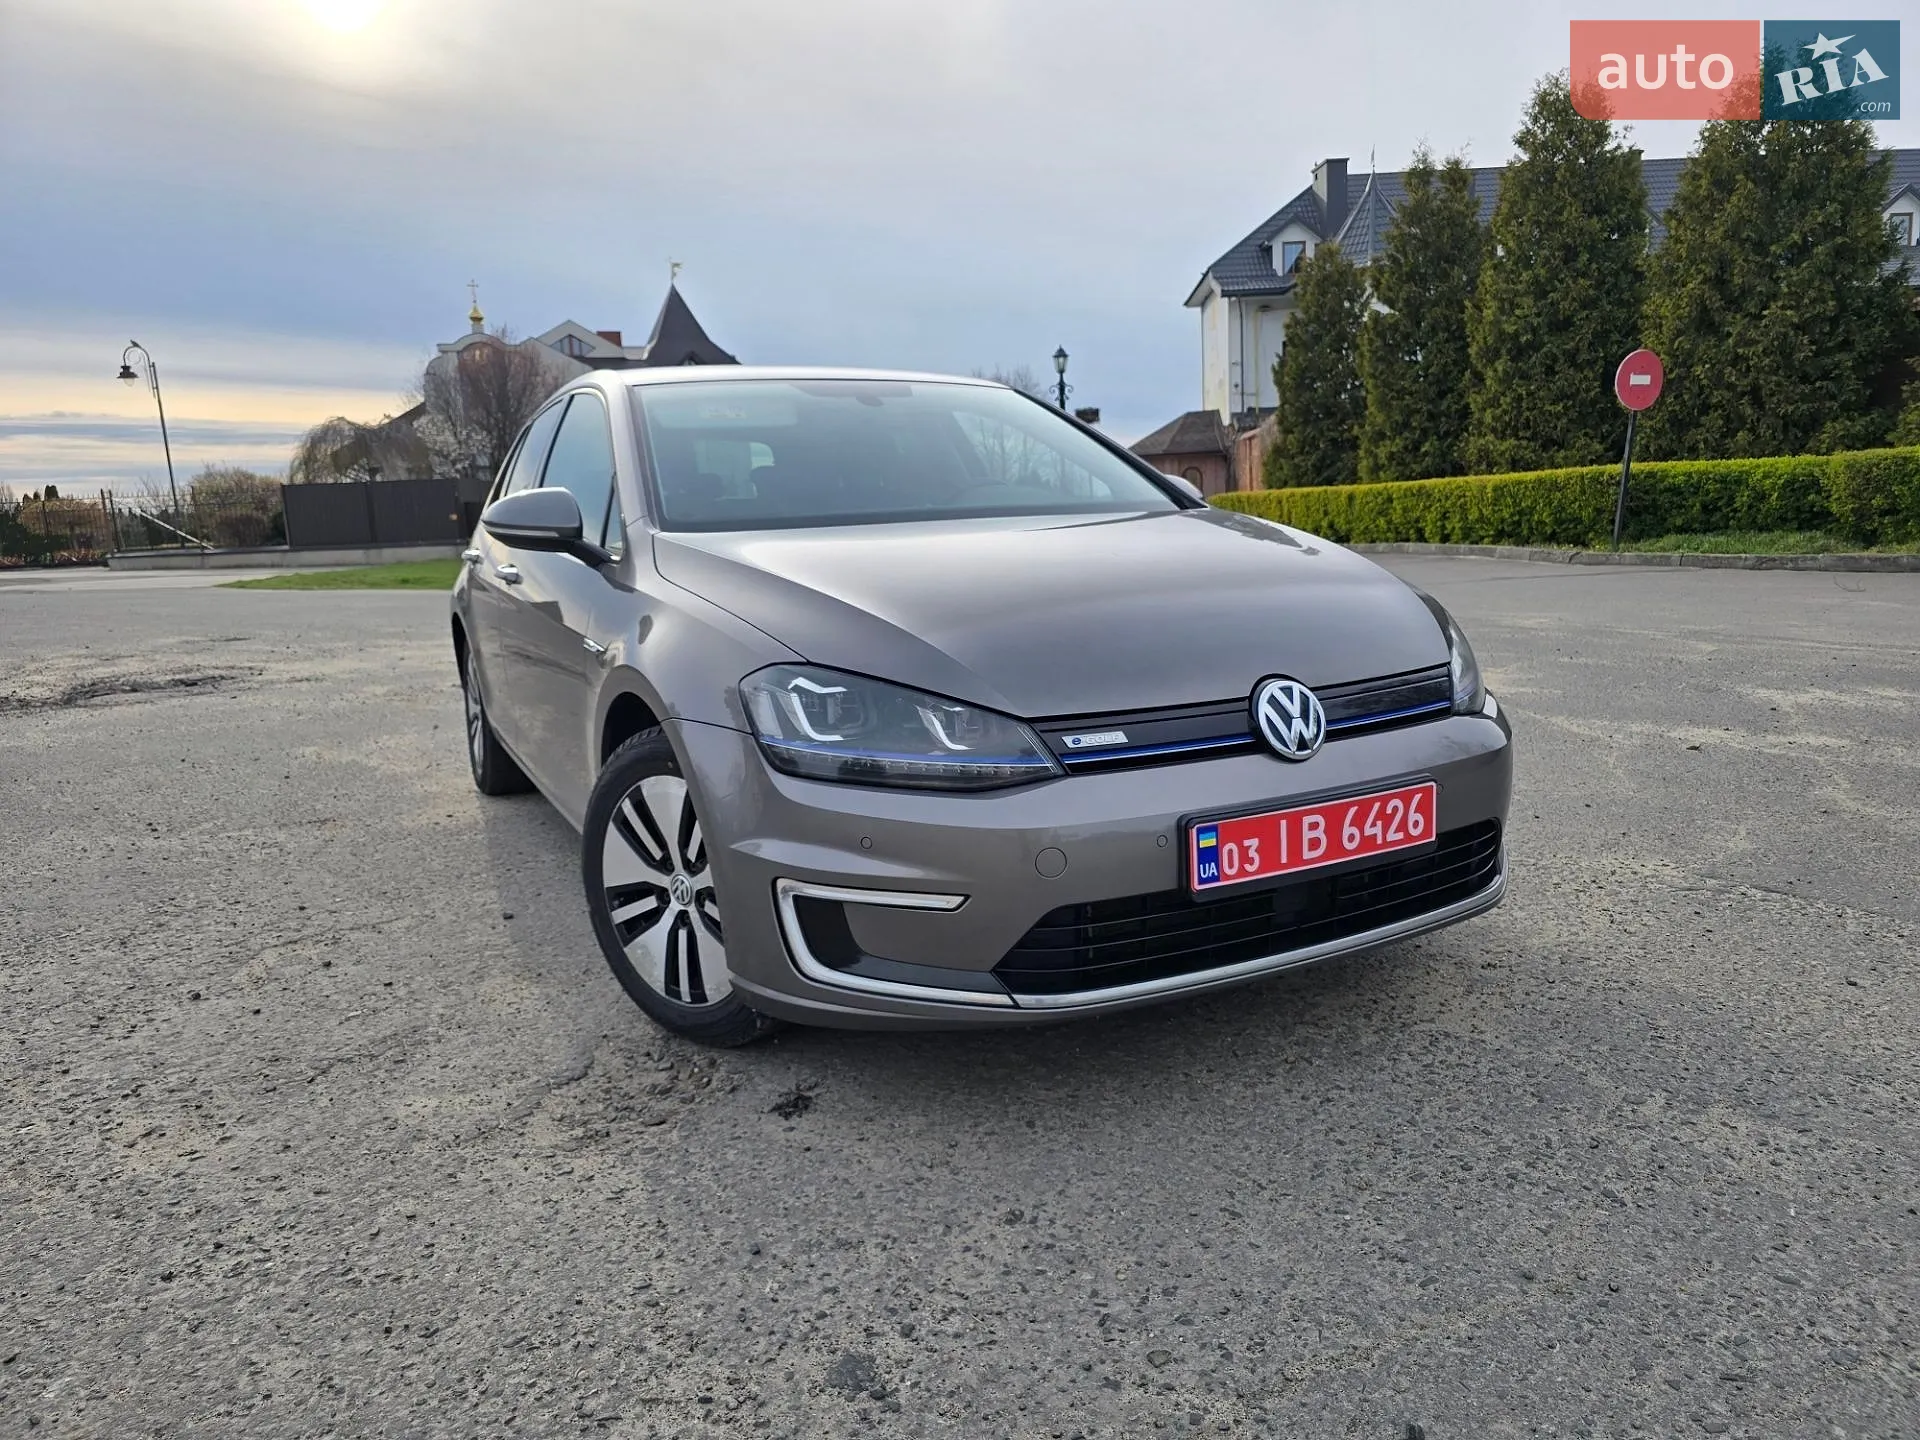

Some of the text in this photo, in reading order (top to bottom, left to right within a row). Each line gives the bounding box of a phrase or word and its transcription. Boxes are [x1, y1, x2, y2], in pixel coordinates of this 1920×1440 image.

[1222, 838, 1260, 876] 03
[1342, 793, 1425, 850] 6426
[1199, 862, 1218, 879] UA
